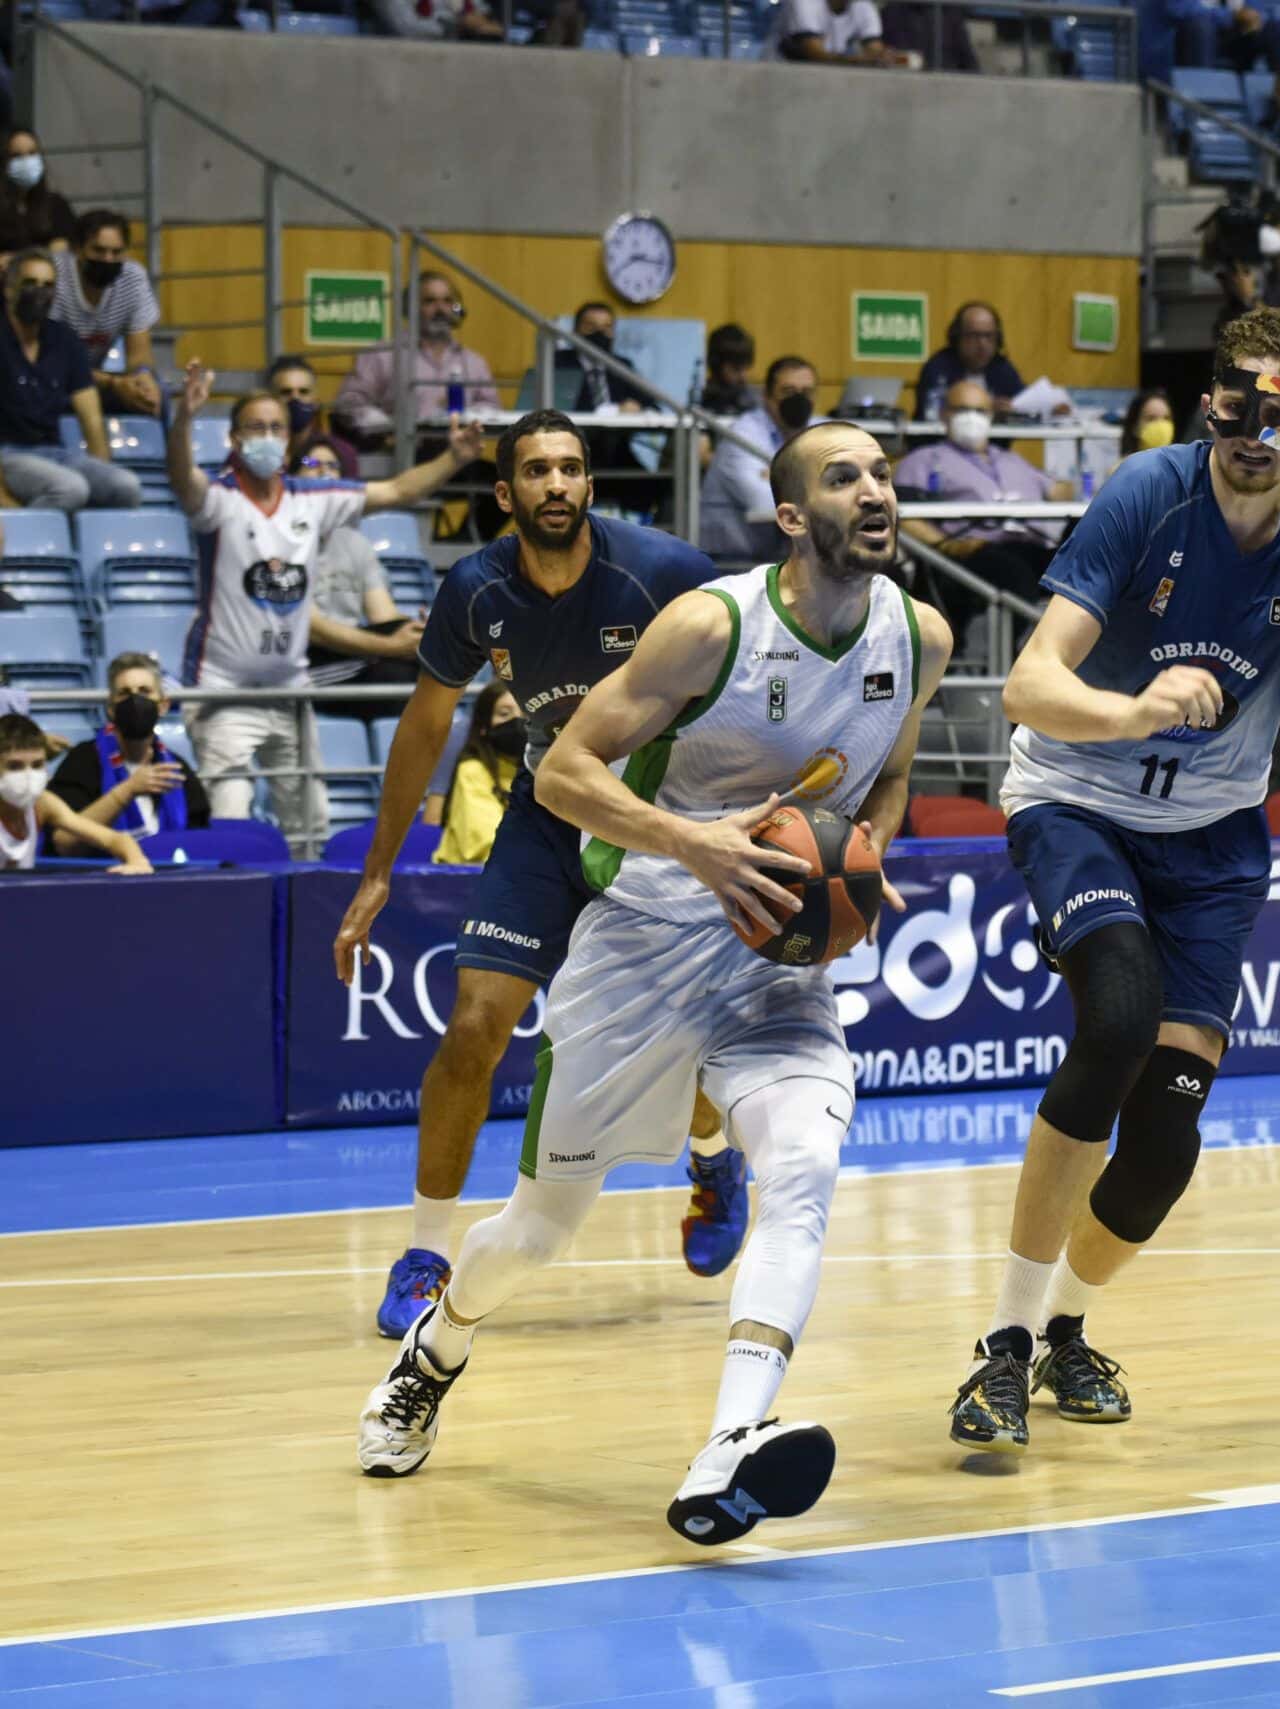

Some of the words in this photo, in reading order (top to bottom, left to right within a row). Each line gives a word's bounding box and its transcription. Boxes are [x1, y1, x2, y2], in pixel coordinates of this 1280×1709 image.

[1150, 642, 1259, 680] OBRADOIRO
[1140, 754, 1180, 799] 11
[477, 921, 541, 950] MONBUS
[549, 1150, 596, 1162] SPALDING
